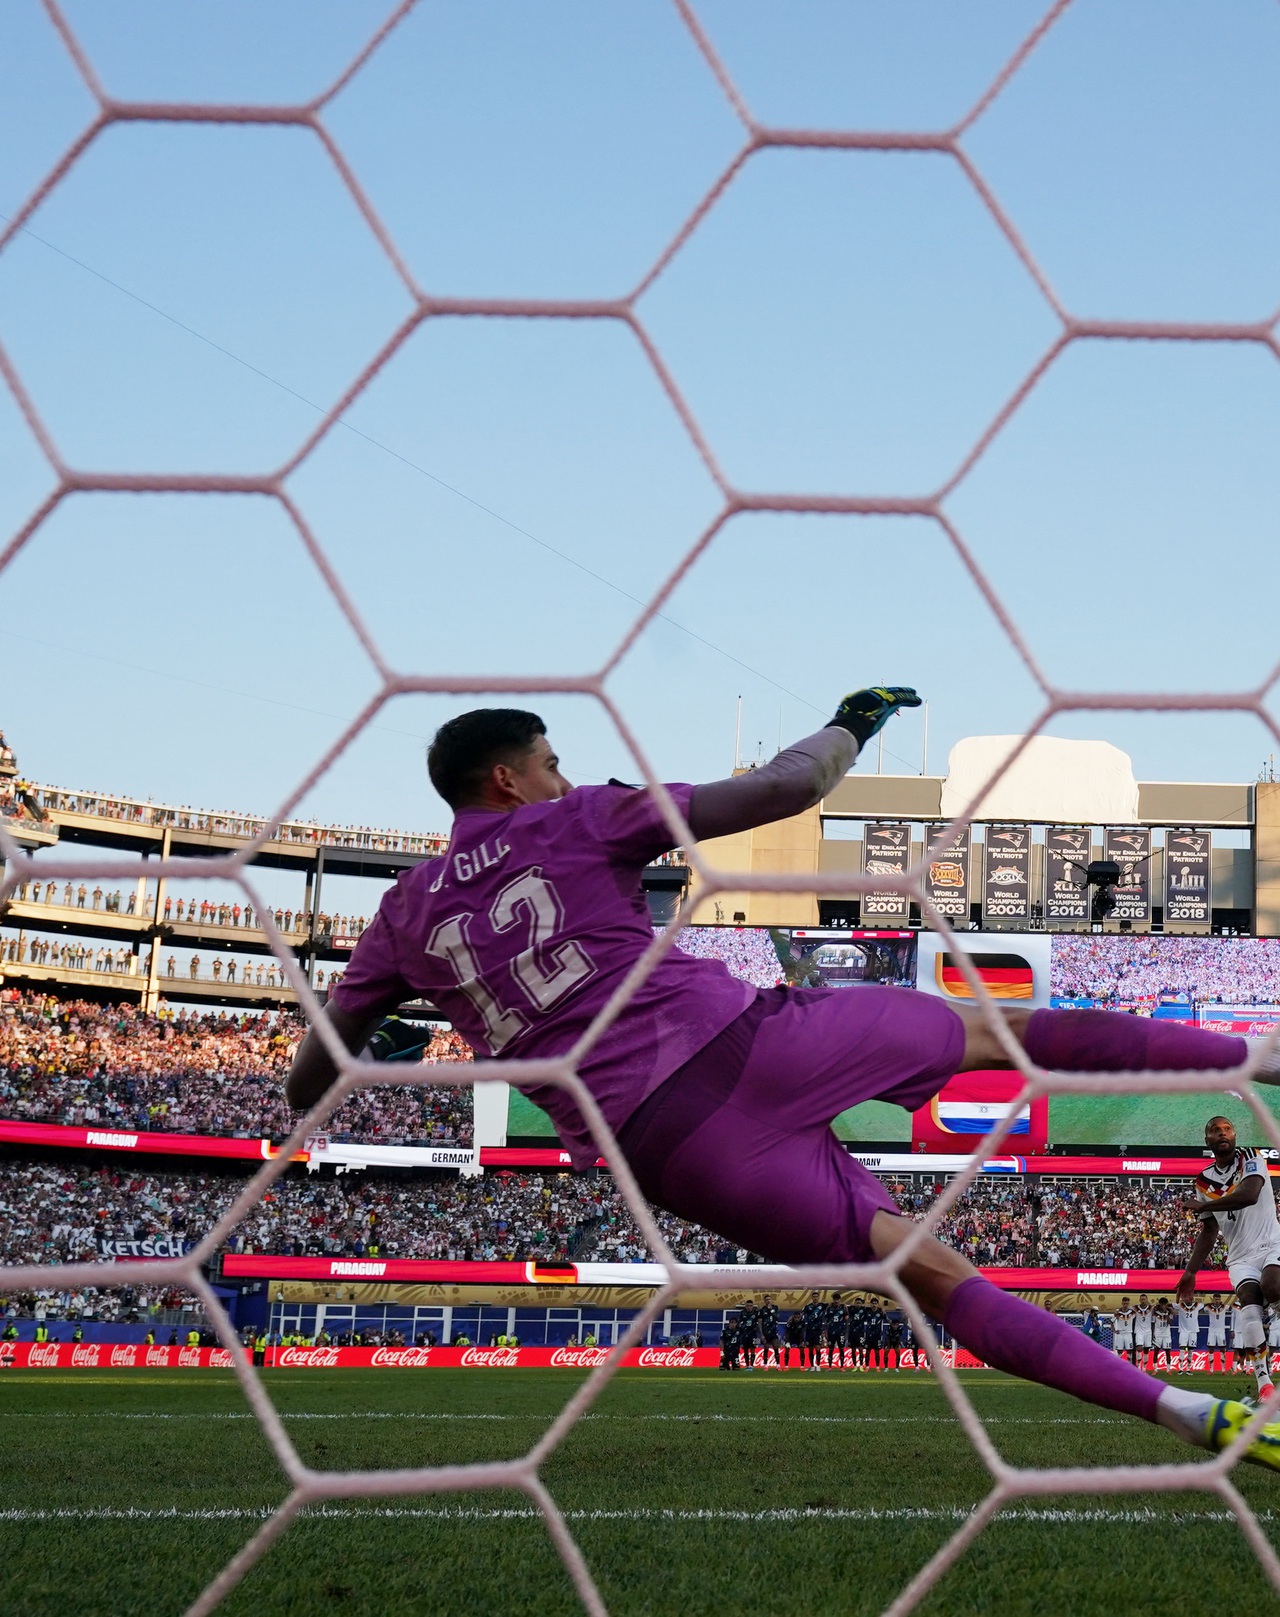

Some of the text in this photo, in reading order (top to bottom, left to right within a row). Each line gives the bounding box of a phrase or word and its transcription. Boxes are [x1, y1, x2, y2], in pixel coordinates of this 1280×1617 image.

[453, 838, 511, 882] GILL
[867, 902, 903, 913] 2001
[987, 905, 1026, 915] 2004
[1050, 906, 1085, 916] 2014
[1110, 907, 1145, 918] 2016
[1170, 908, 1205, 919] 2018
[425, 866, 599, 1057] 12
[1203, 1020, 1232, 1032] Coca-Cola
[86, 1131, 138, 1148] PARAGUAY
[308, 1137, 327, 1150] 79
[854, 1158, 880, 1167] MANY
[1122, 1160, 1161, 1171] PARAGUAY
[102, 1240, 184, 1257] KETSCH
[331, 1262, 386, 1276] PARAGUAY
[1077, 1272, 1128, 1286] PARAGUAY
[28, 1343, 60, 1366] Coca-Cola
[71, 1344, 100, 1366] Coca-Cola
[280, 1347, 697, 1367] Coca-Cola Coca-Cola Coca-Cola Coca-Cola Coca-Cola
